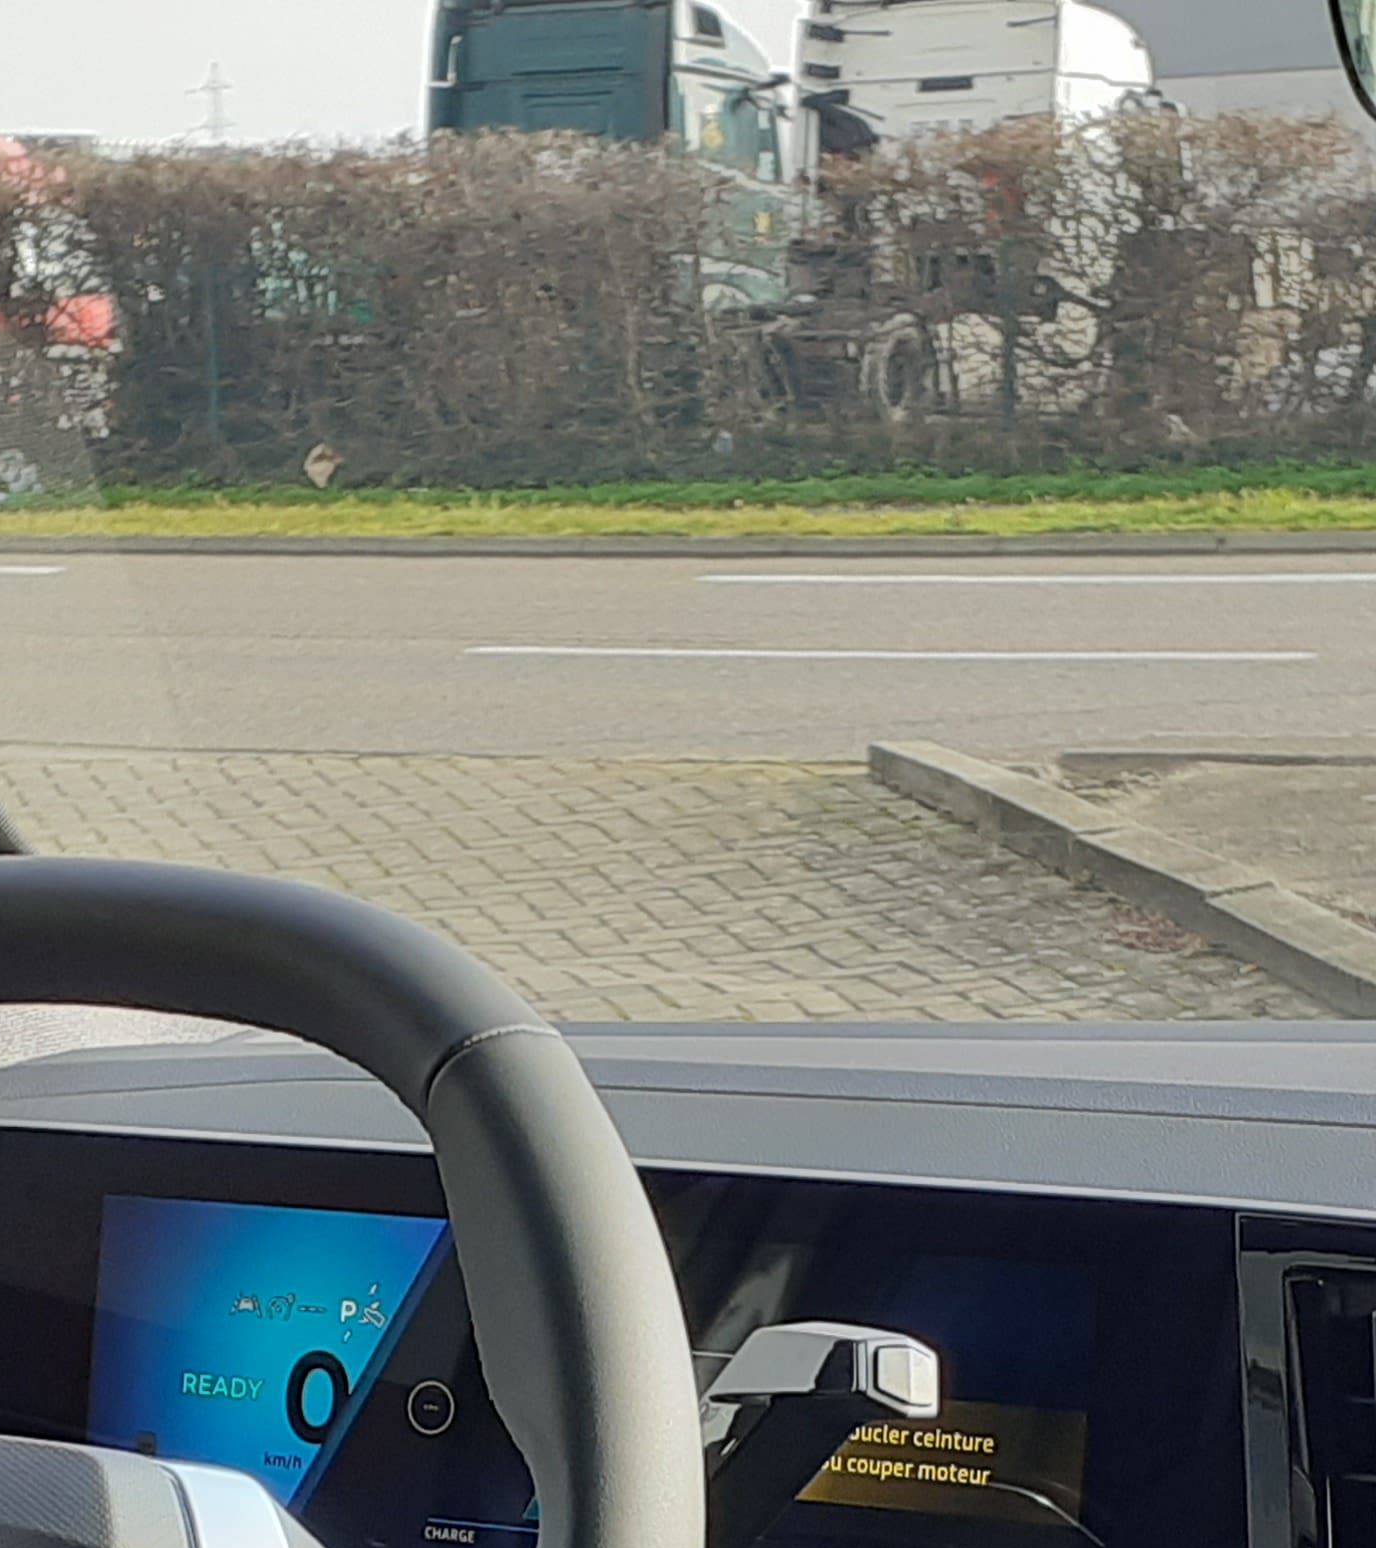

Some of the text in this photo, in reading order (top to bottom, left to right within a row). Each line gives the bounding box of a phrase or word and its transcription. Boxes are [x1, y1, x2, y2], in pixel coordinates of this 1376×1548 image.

[340, 1299, 358, 1323] P
[181, 1371, 264, 1400] READY
[285, 1349, 353, 1445] 0
[849, 1424, 995, 1454] ucler ceinture
[263, 1451, 303, 1470] km/h
[847, 1457, 913, 1481] couper
[917, 1463, 992, 1486] moteur
[424, 1525, 475, 1544] CHARGE
